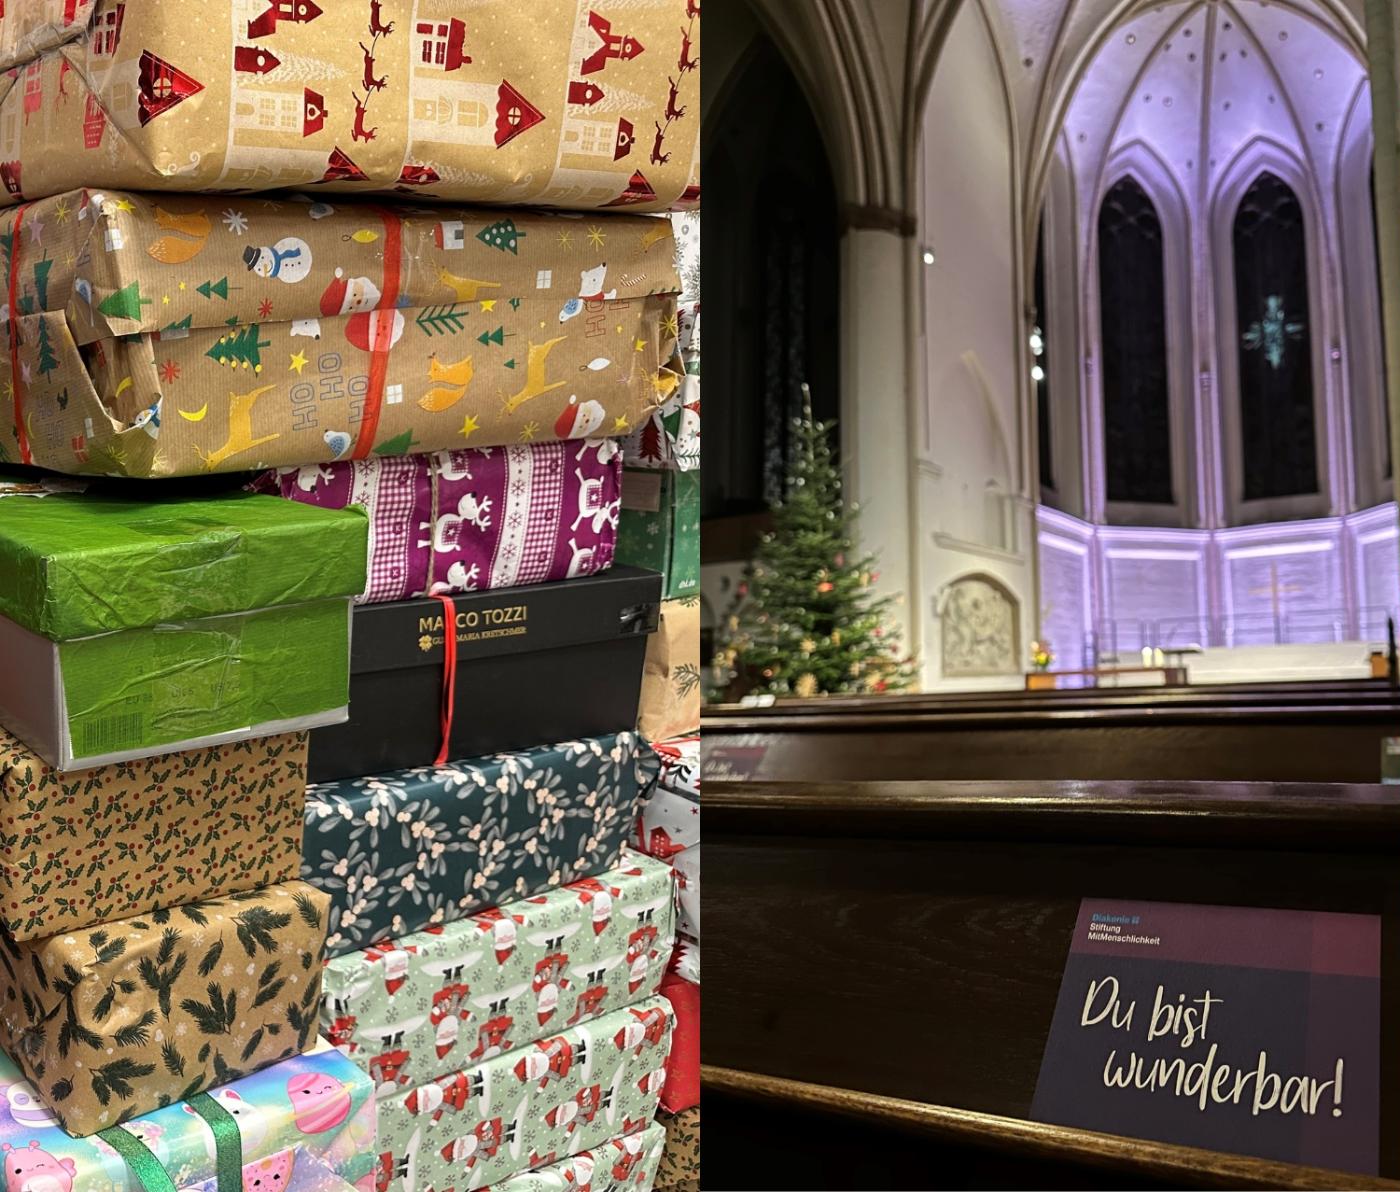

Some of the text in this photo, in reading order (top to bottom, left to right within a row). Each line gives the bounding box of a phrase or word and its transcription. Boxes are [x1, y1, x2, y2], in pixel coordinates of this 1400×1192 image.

[318, 352, 344, 400] HO
[290, 383, 318, 431] HO
[419, 606, 527, 632] MACO TOZZI
[1090, 922, 1121, 934] Stiftung
[1092, 913, 1131, 924] Diakonie
[1088, 932, 1160, 945] MitMenschlichkeit
[1081, 975, 1224, 1048] Du bist
[1103, 1043, 1344, 1118] wunderbar!
